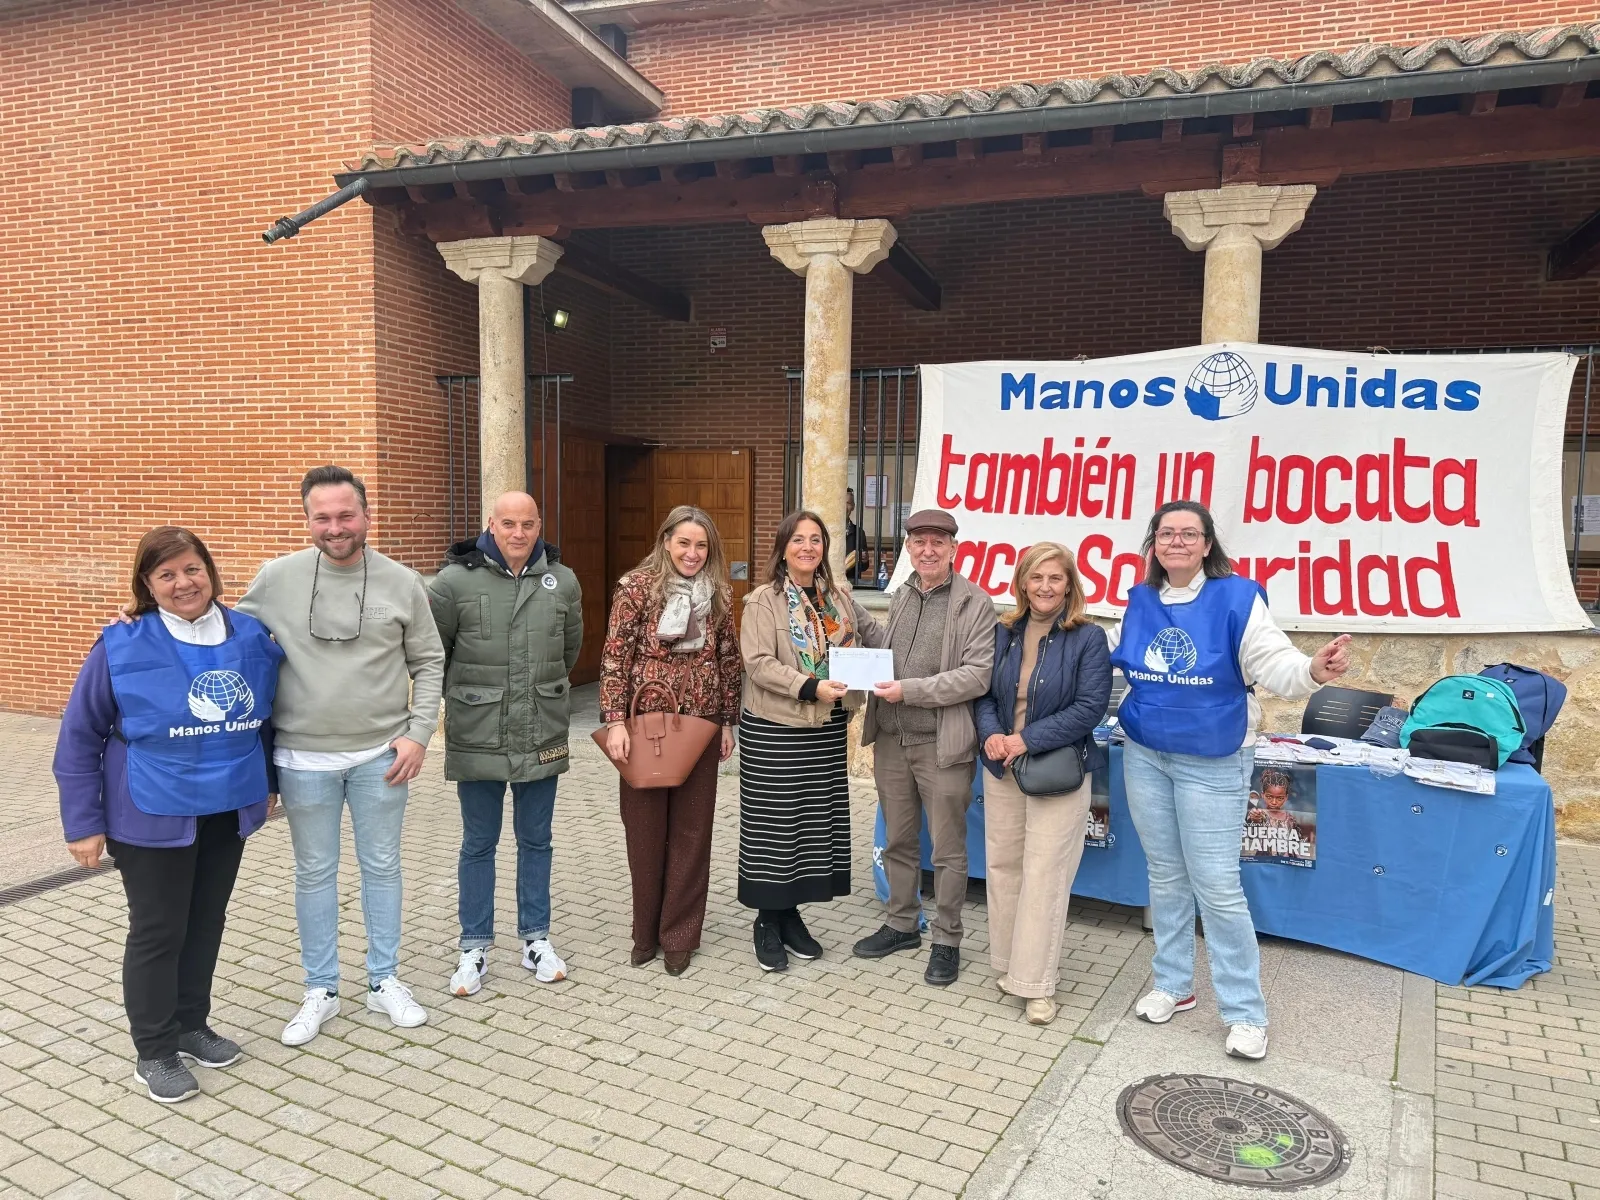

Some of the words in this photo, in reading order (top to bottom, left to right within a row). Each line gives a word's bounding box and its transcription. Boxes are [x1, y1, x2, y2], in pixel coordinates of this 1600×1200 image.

[1001, 372, 1176, 411] Manos
[1264, 362, 1481, 412] Unidas
[936, 434, 1137, 520] también
[1155, 451, 1215, 507] un
[1243, 436, 1480, 528] bocata
[953, 540, 1032, 598] ac
[1077, 533, 1461, 618] Soridad
[1129, 670, 1164, 683] Manos
[1167, 674, 1214, 685] Unidas
[169, 724, 221, 738] Manos
[225, 719, 263, 732] Unida
[1240, 837, 1311, 857] HAMBRE
